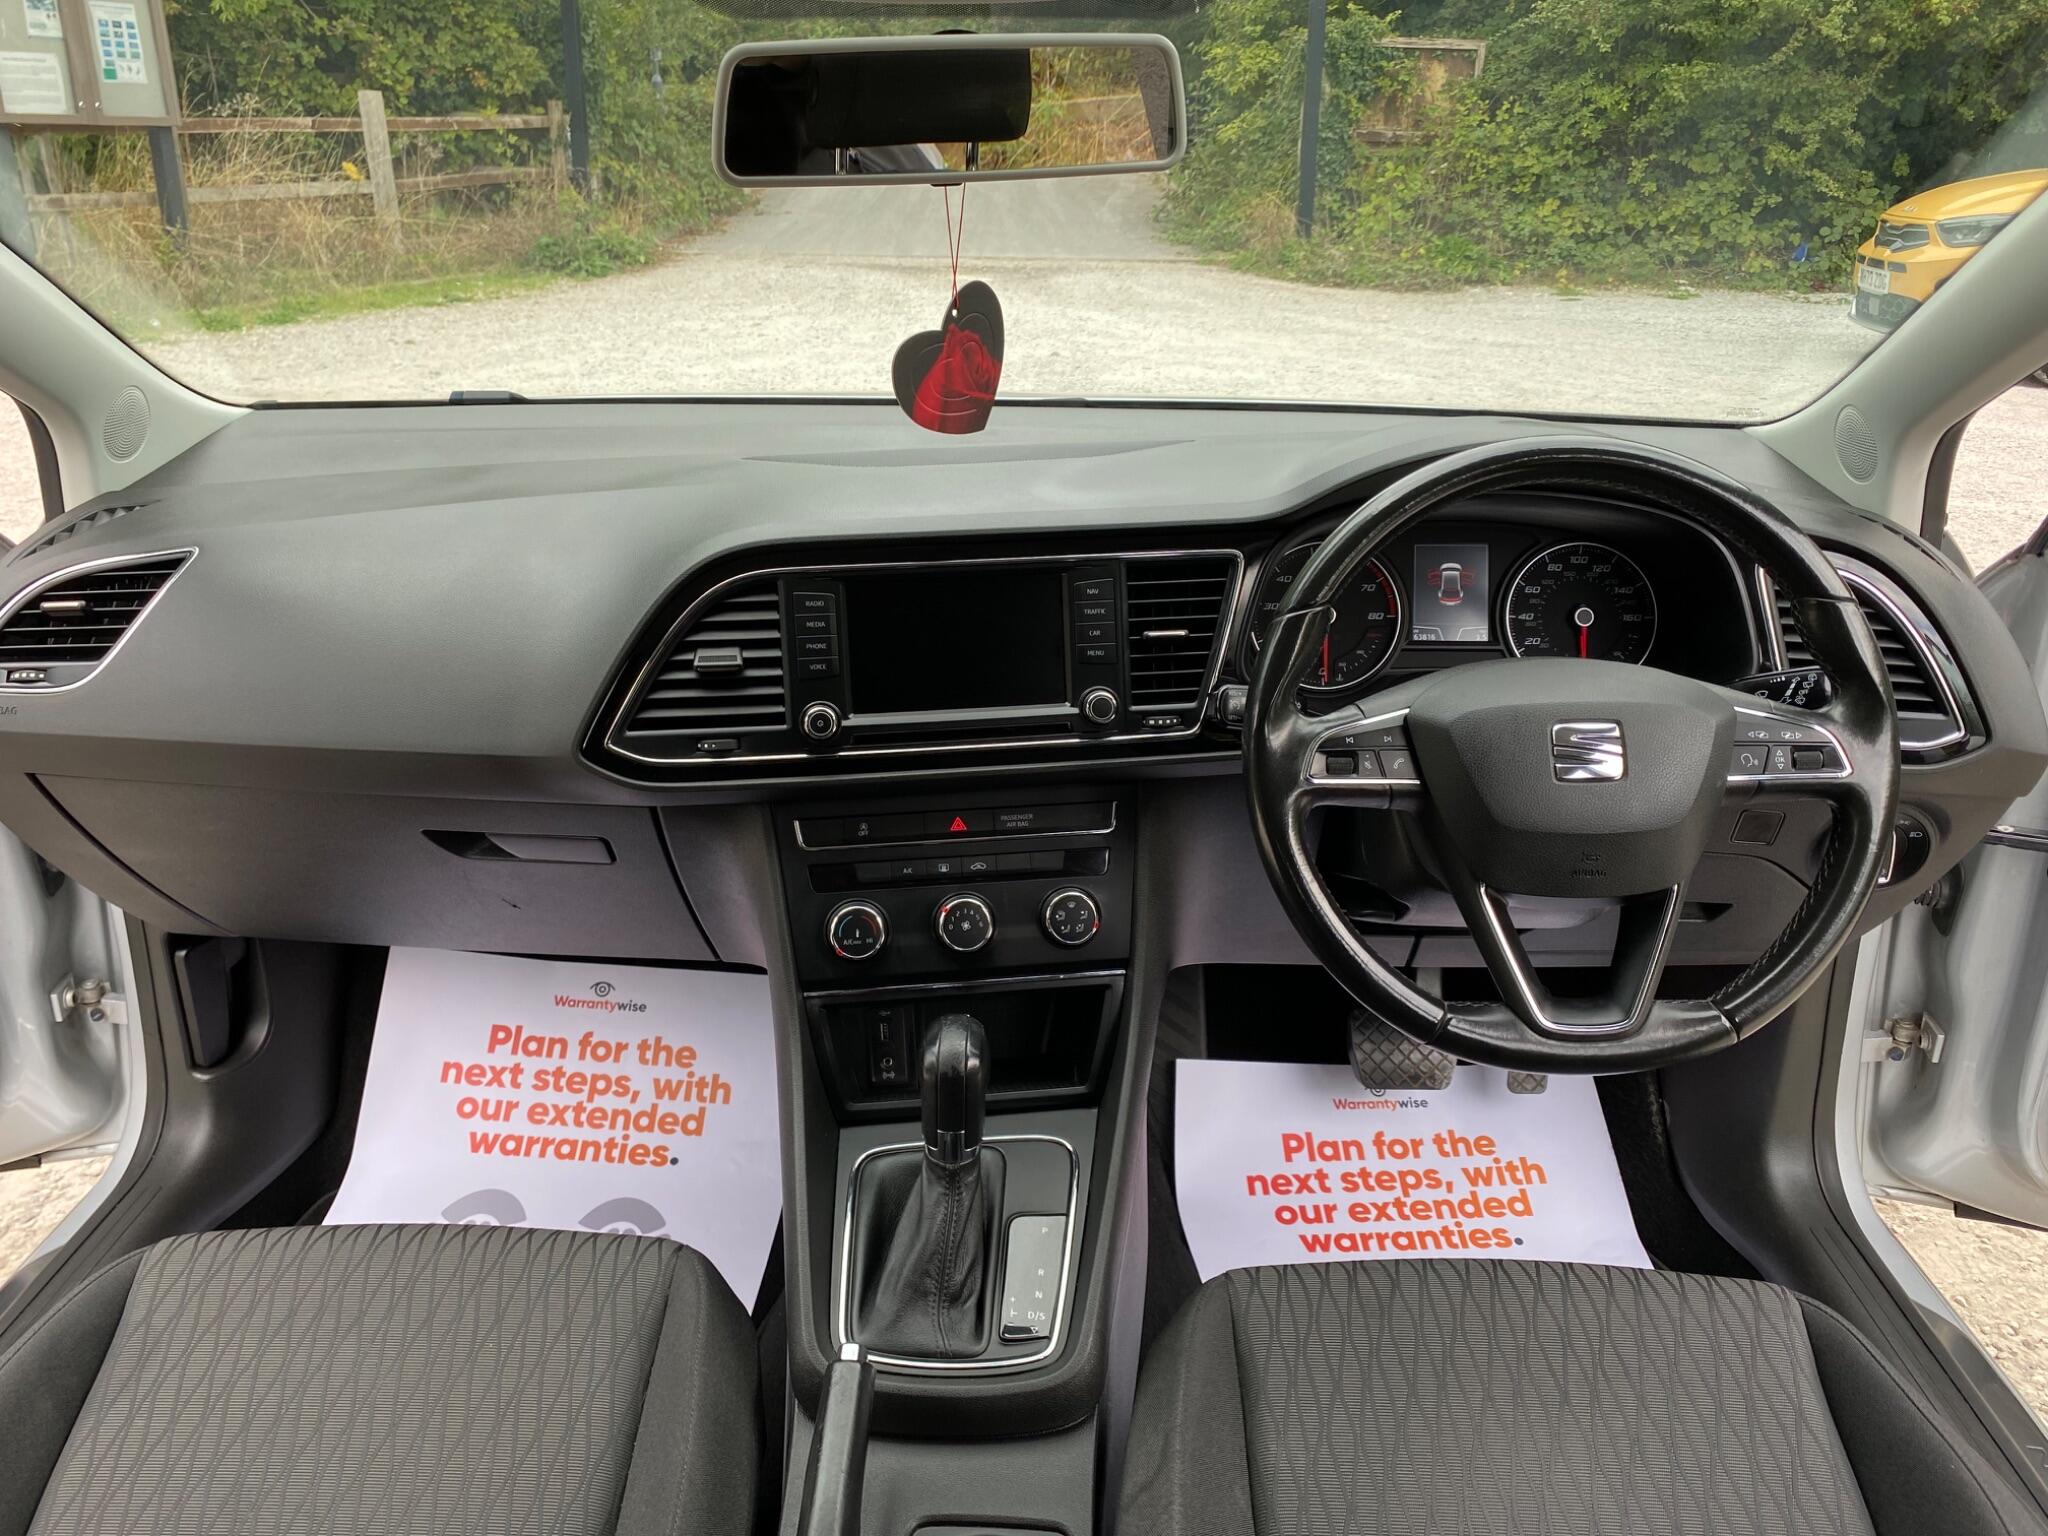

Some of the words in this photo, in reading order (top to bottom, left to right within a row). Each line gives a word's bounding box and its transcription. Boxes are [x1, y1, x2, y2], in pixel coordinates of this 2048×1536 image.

[1570, 556, 1589, 564] 100
[1547, 564, 1563, 572] 80
[1276, 575, 1292, 583] 40
[1360, 584, 1376, 592] 70
[1524, 586, 1541, 594] 60
[1614, 586, 1634, 594] 140
[1263, 602, 1279, 610] 30
[1367, 612, 1385, 620] 80
[1524, 637, 1541, 645] 20
[1000, 813, 1034, 821] PASSENGER
[554, 994, 647, 1014] Warrantywise
[487, 1023, 569, 1060] Plan
[577, 1030, 629, 1064] for
[637, 1036, 697, 1069] the
[440, 1058, 524, 1091] next
[531, 1066, 640, 1105] steps,
[651, 1073, 732, 1105] with
[1333, 1096, 1429, 1112] Warrantywise
[455, 1096, 518, 1123] our
[526, 1099, 707, 1137] extended
[468, 1129, 680, 1168] warranties.
[1281, 1131, 1364, 1163] Plan
[1372, 1130, 1424, 1161] for
[1432, 1129, 1497, 1158] the
[1246, 1167, 1331, 1197] next
[1340, 1162, 1454, 1197] steps,
[1461, 1157, 1547, 1187] with
[1274, 1201, 1339, 1227] our
[1347, 1188, 1533, 1224] extended
[1299, 1221, 1524, 1253] warranties.
[1027, 1311, 1046, 1320] D/S
